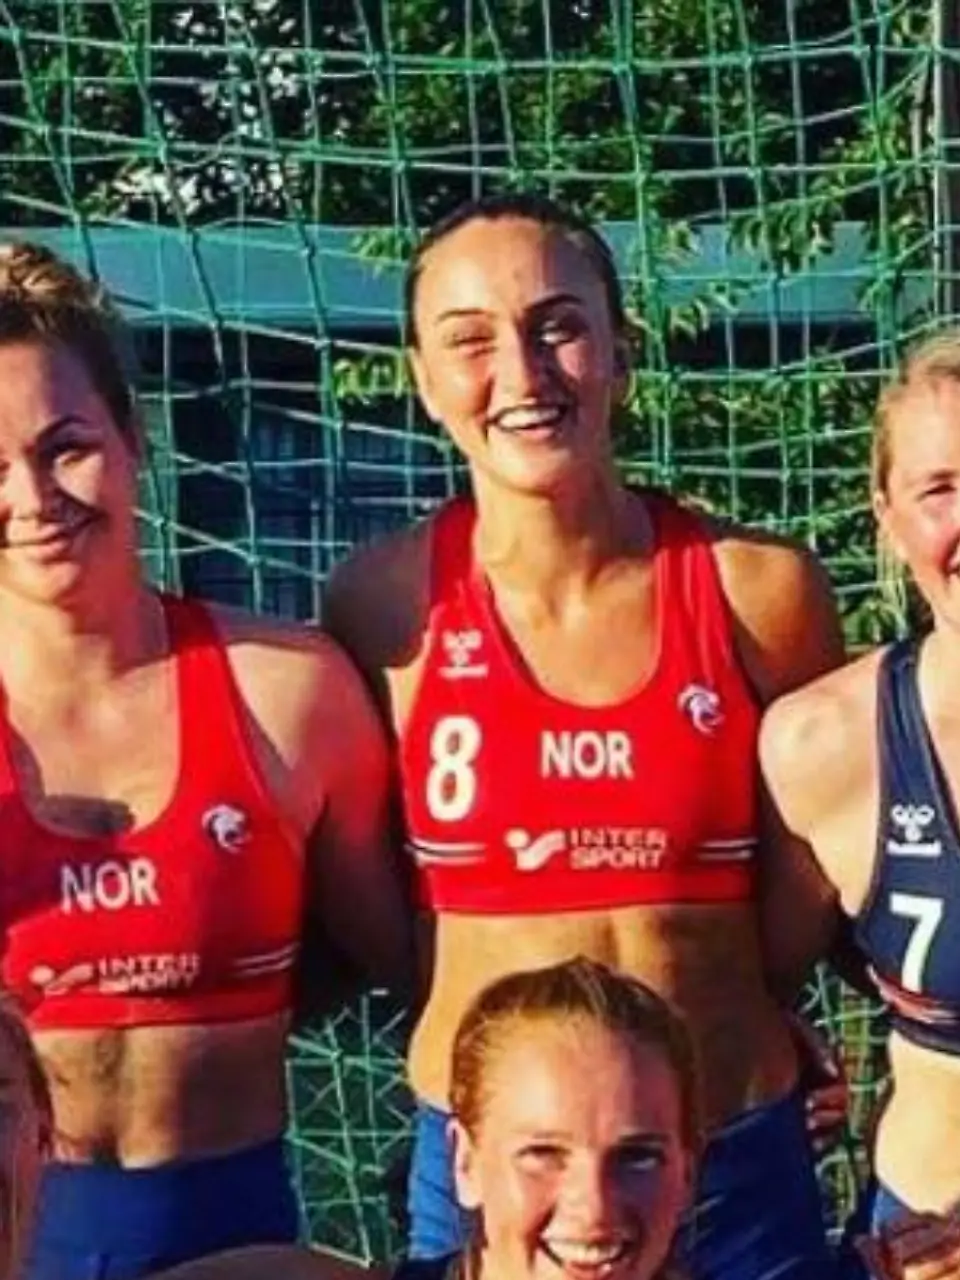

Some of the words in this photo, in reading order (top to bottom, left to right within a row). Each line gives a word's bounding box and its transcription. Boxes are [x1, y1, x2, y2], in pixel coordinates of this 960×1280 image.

[426, 714, 482, 822] 8
[540, 730, 635, 780] NOR
[569, 827, 668, 850] INTER
[570, 847, 664, 870] SPORT
[60, 857, 160, 914] NOR
[888, 892, 944, 993] 7
